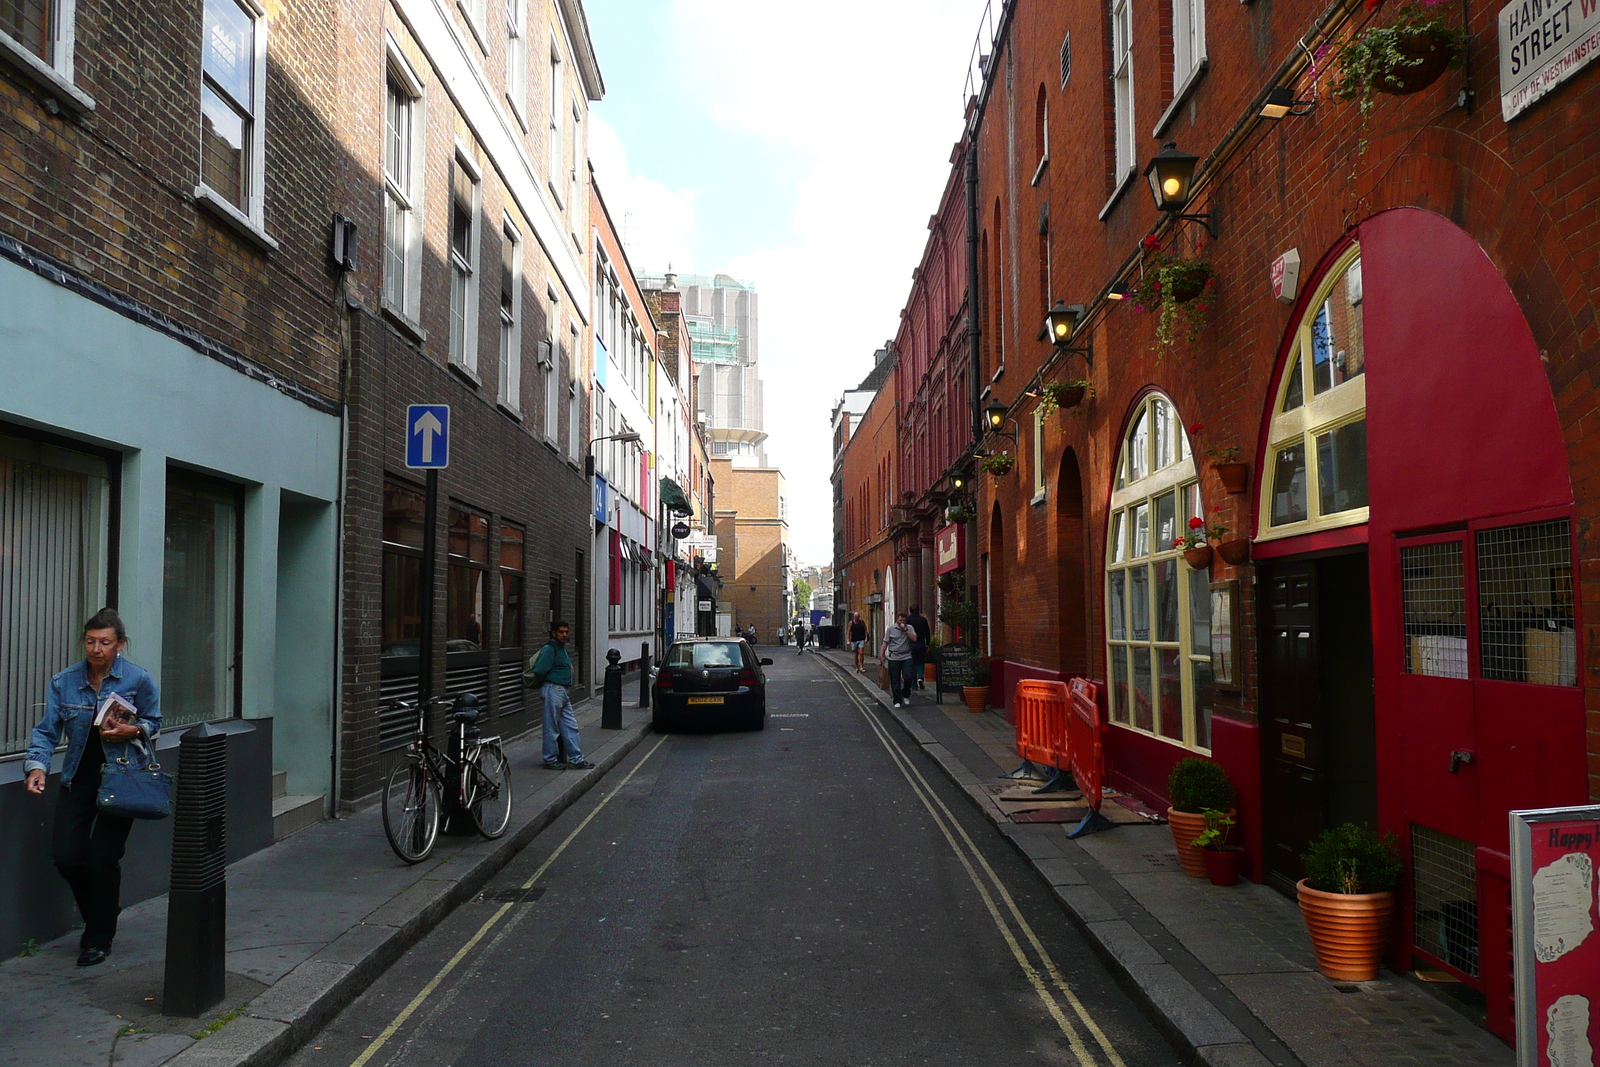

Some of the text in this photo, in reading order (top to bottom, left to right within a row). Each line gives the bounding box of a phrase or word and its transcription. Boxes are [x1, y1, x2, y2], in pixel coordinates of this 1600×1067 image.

[1511, 1, 1573, 76] STREET
[1512, 31, 1600, 108] CITY OF WESTMINSTER
[596, 483, 603, 514] 24
[1548, 828, 1593, 850] Happy
